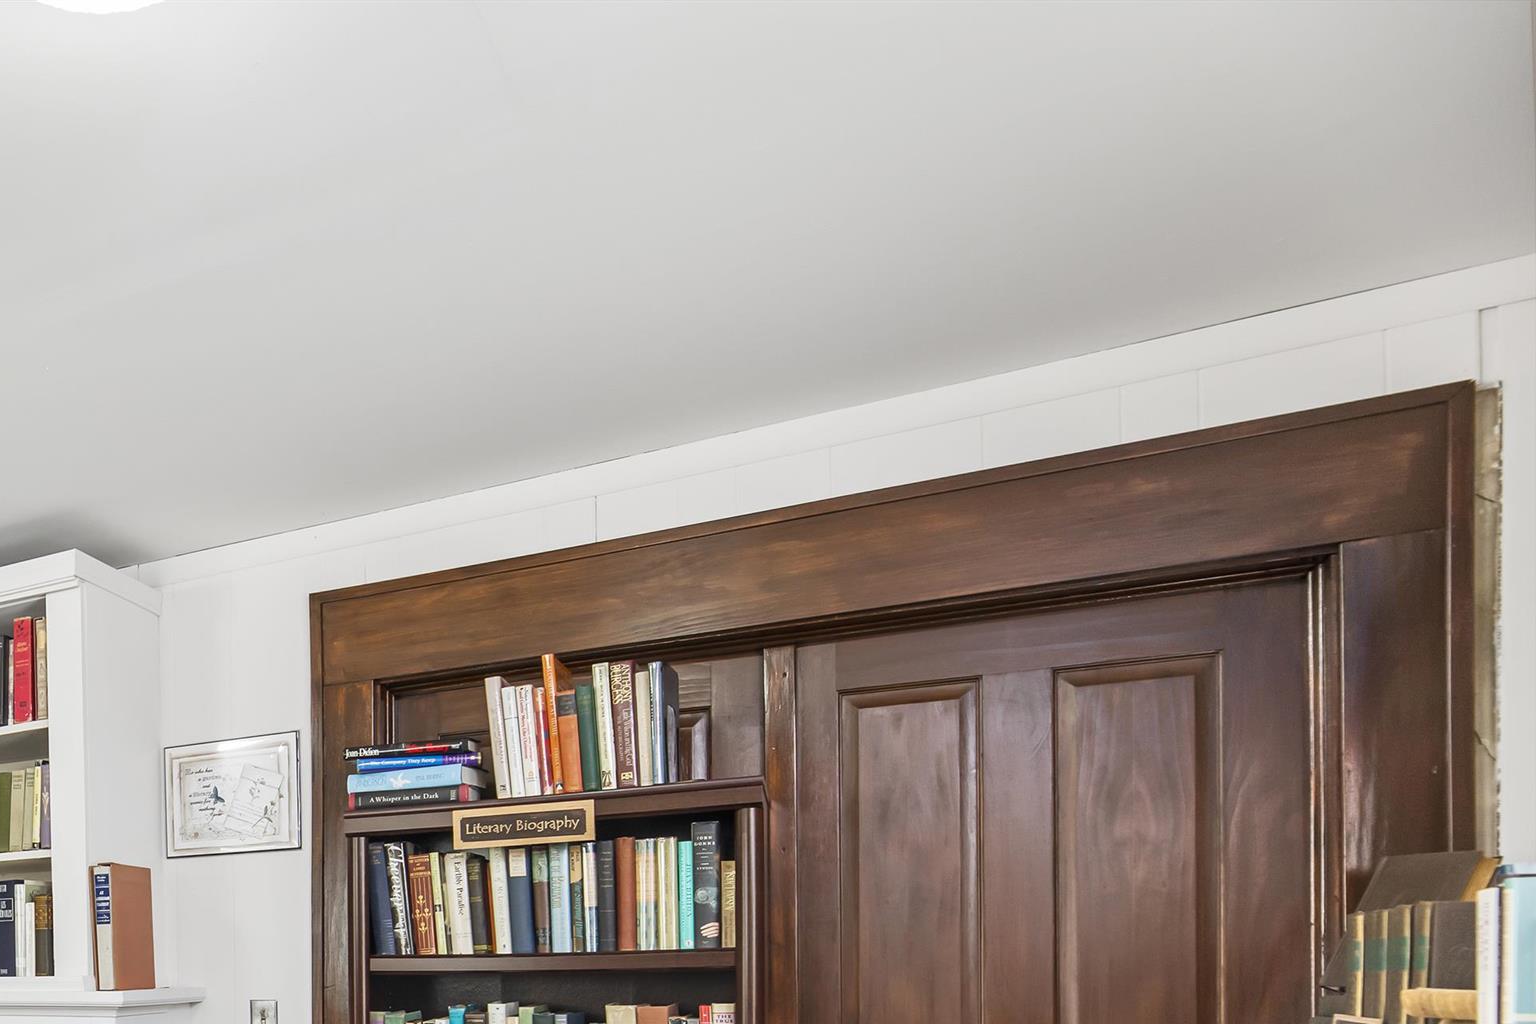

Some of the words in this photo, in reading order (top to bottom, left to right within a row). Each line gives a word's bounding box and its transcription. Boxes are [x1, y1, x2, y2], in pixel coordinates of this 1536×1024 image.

[610, 664, 622, 705] BURGESS
[620, 664, 633, 703] ANTHONY
[374, 795, 401, 803] Whisper
[423, 792, 439, 800] Dark
[465, 823, 513, 835] Literary
[516, 815, 580, 831] Biography
[454, 861, 463, 886] Earthly
[455, 887, 465, 916] Paradise
